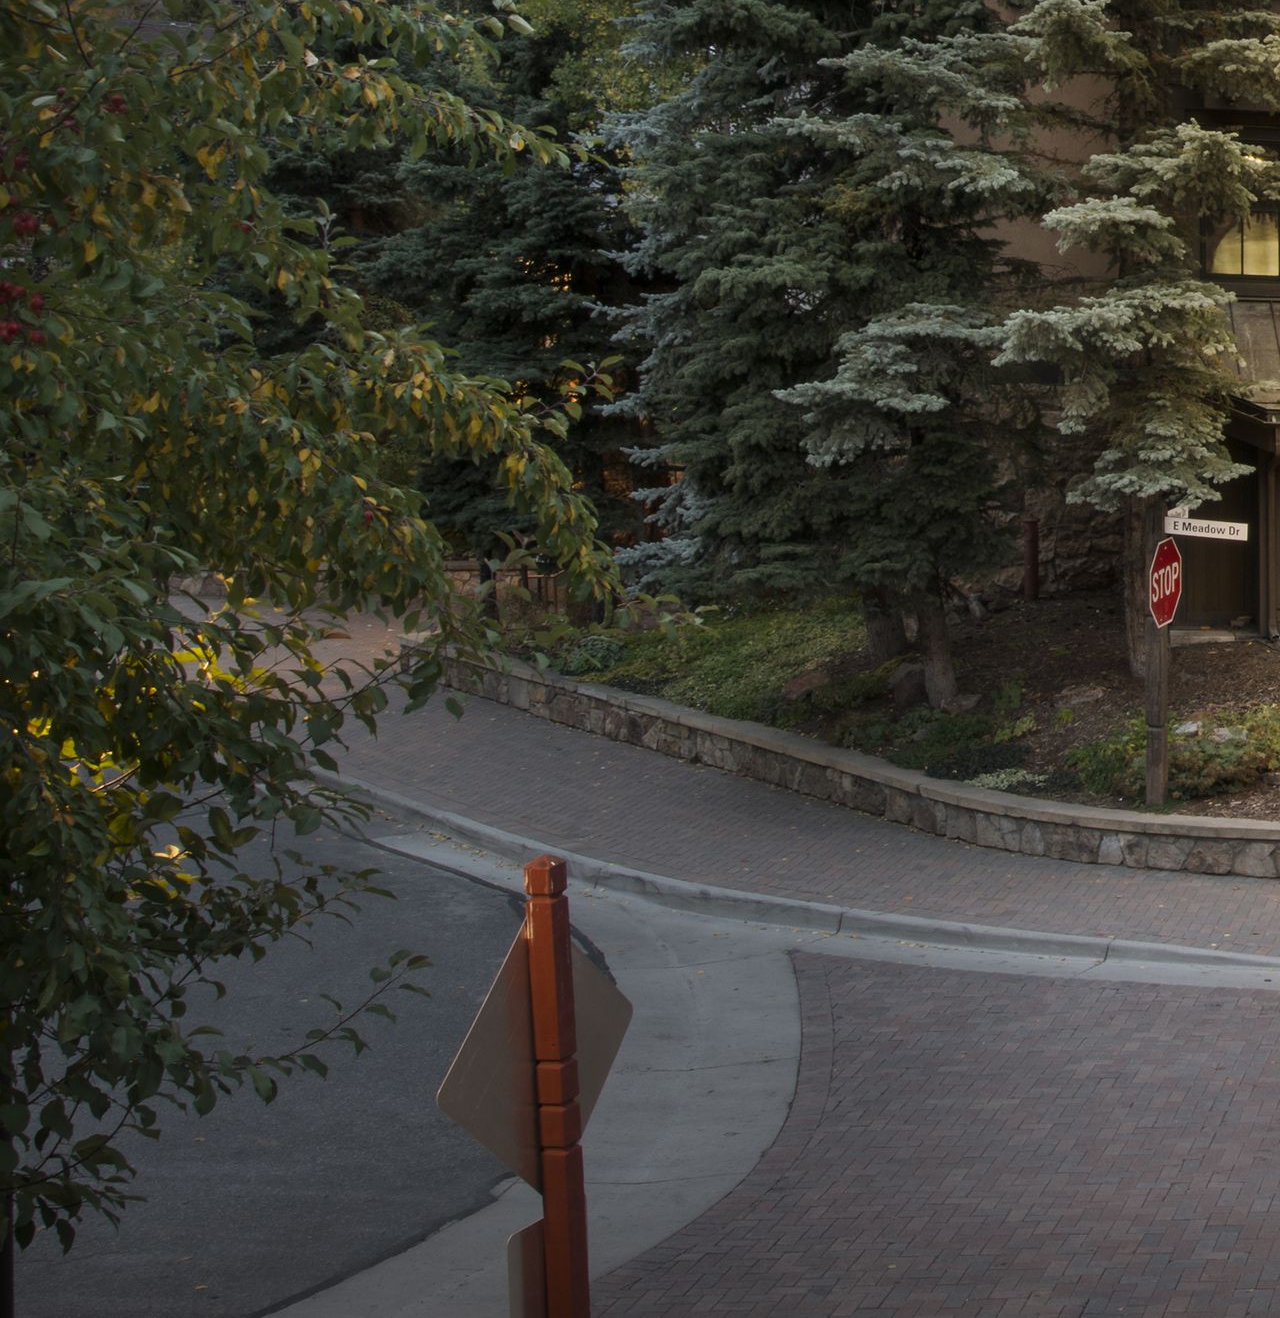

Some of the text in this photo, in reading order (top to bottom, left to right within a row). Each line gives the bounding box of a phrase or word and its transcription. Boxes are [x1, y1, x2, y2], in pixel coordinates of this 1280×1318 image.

[1173, 521, 1241, 536] E Meadow Dr
[1152, 562, 1179, 603] STOP
